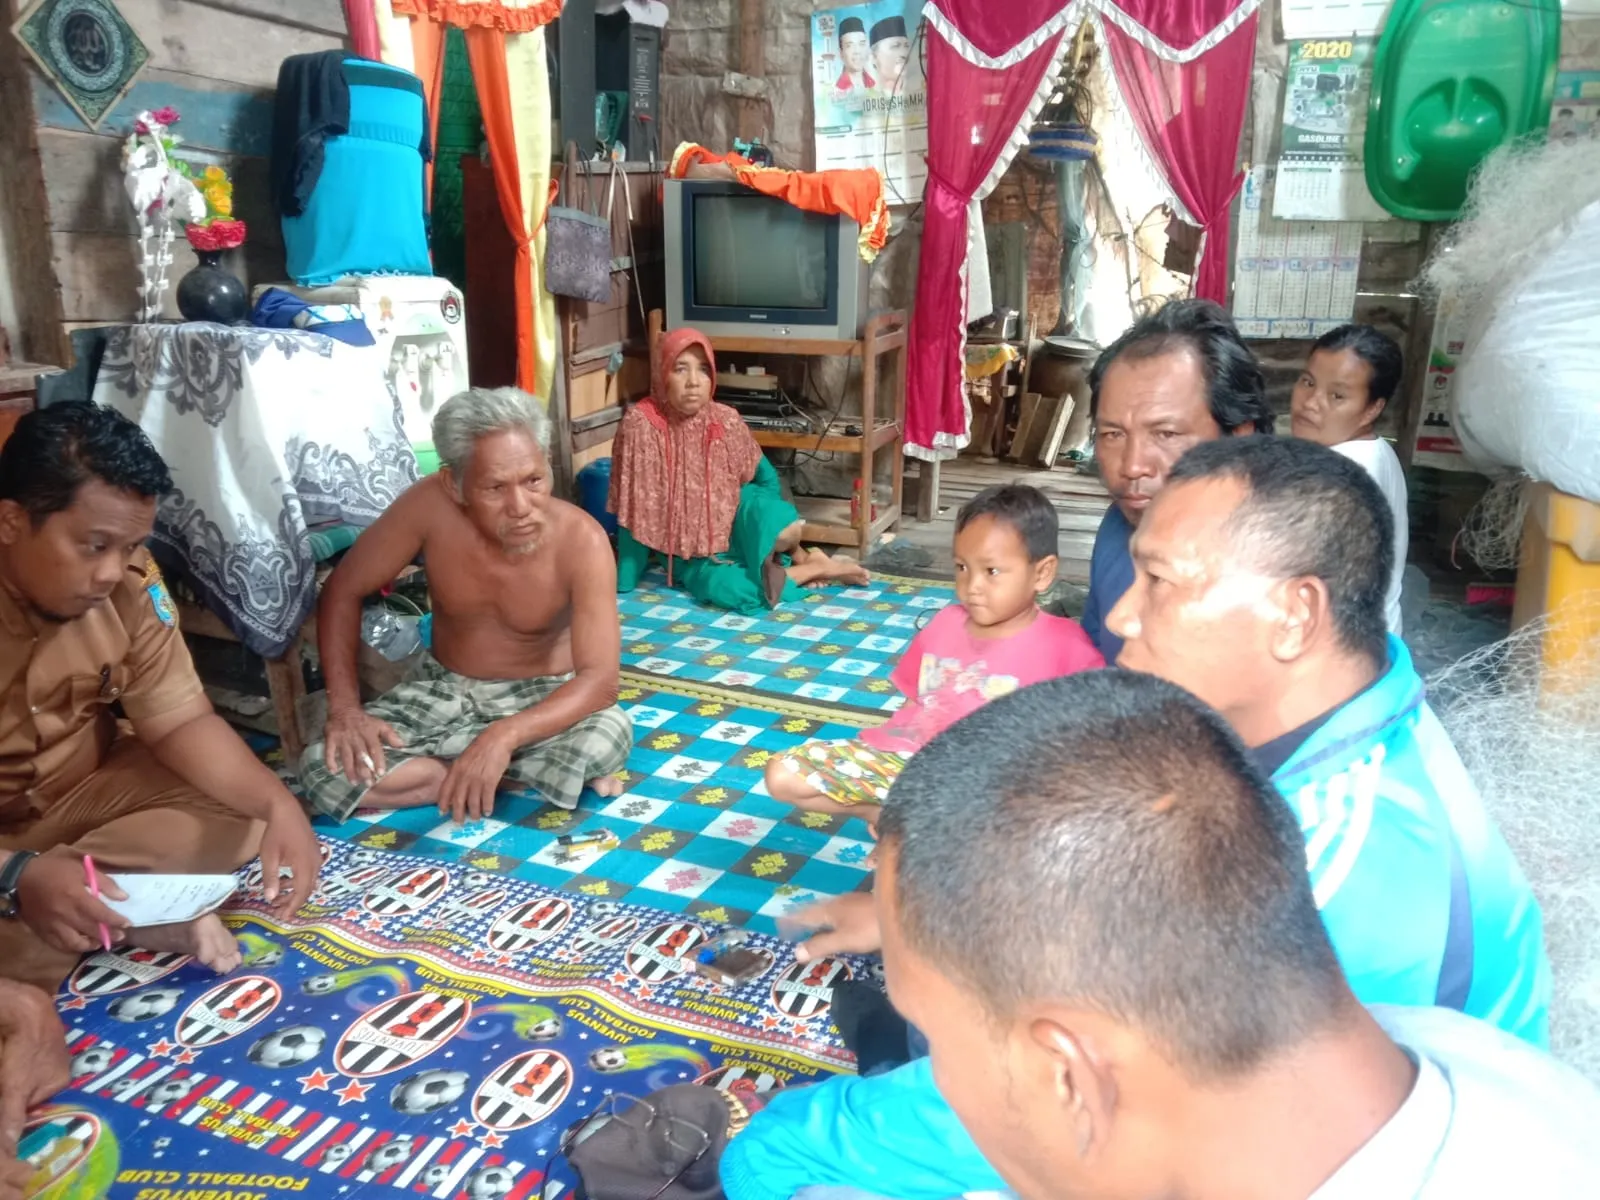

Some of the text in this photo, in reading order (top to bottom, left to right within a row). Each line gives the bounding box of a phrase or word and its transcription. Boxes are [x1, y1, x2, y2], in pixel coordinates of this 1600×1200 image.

[1302, 41, 1353, 60] 2020
[863, 97, 886, 112] IDRIS
[1298, 134, 1341, 143] GASOLINE
[289, 941, 349, 971] JUVENTUS
[316, 938, 373, 966] FOOTBALL
[414, 966, 508, 998] FOOTBALL CLUB
[421, 983, 482, 1002] JUVENTUS
[592, 1006, 657, 1039] FOOTBALL
[683, 1000, 739, 1021] JUVENTUS
[566, 1009, 633, 1044] JUVENTUS
[351, 1028, 427, 1055] JUVENTUS
[709, 1043, 818, 1076] FOOTBALL CLUB
[721, 1058, 794, 1080] JUVENTUS
[196, 1096, 301, 1139] FOOTBALL CLUB
[199, 1115, 268, 1145] JUVENTUS
[116, 1169, 310, 1191] FOOTBALL CLUB
[134, 1188, 268, 1200] JUVENTUS
